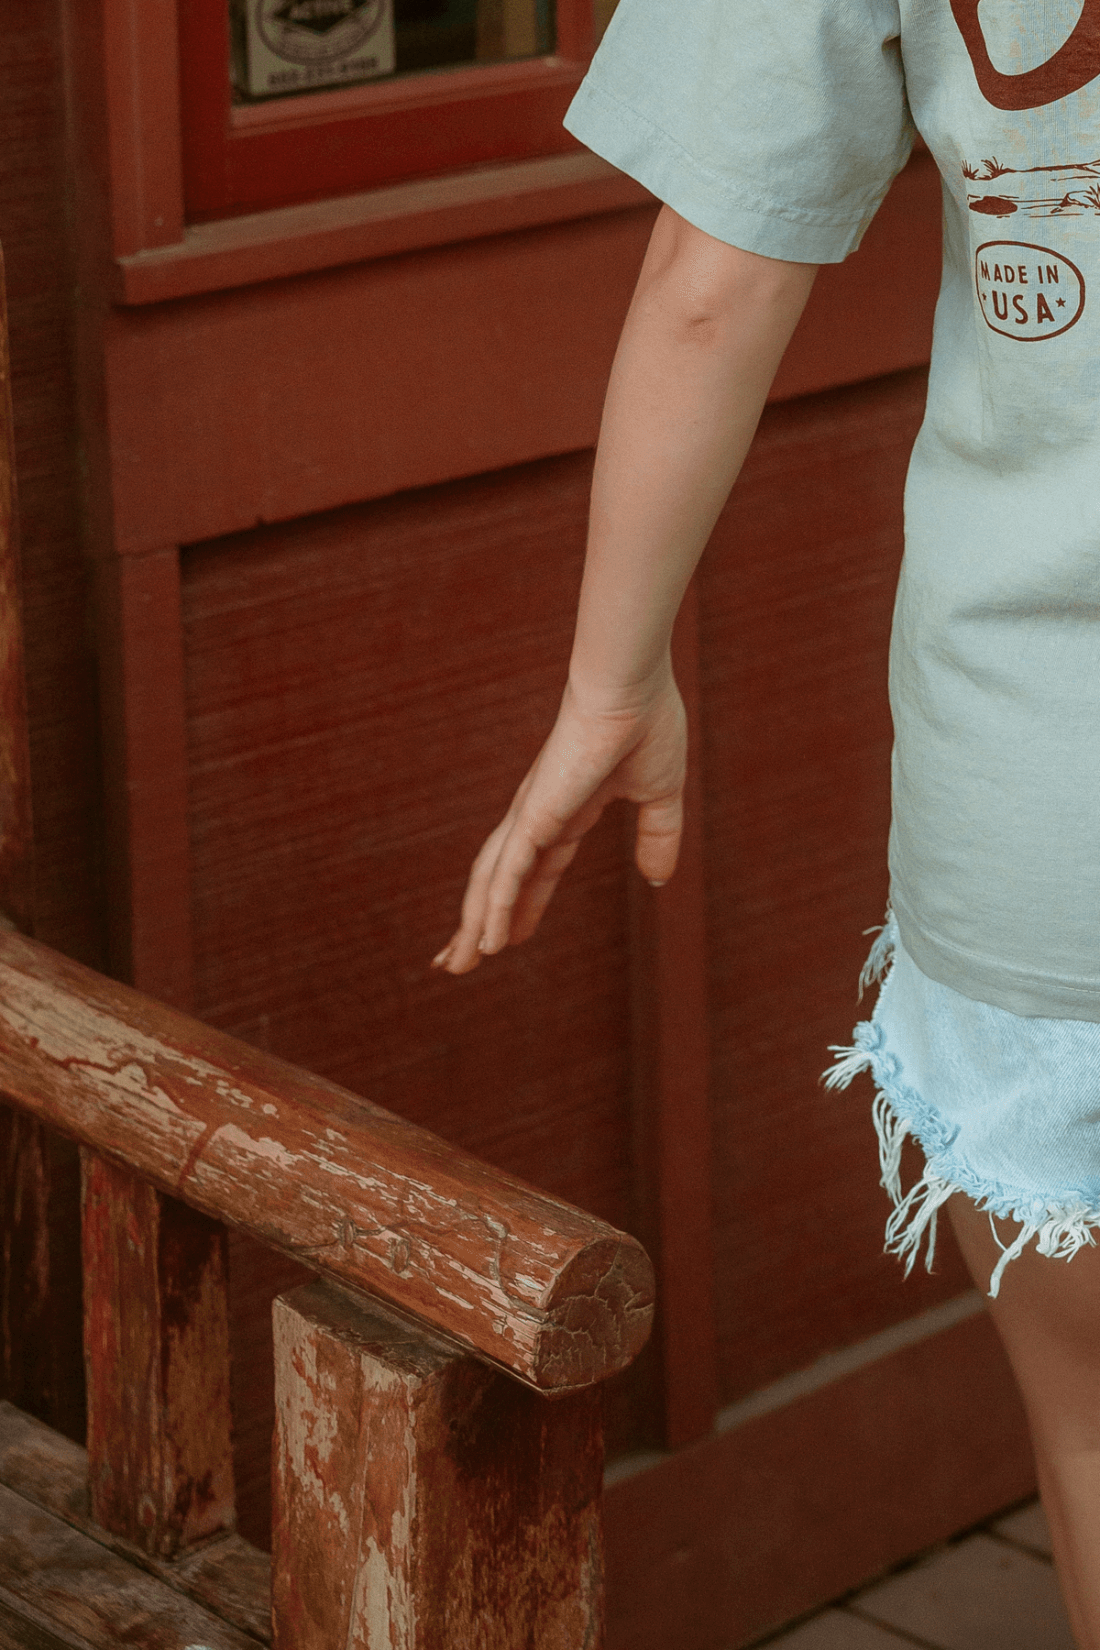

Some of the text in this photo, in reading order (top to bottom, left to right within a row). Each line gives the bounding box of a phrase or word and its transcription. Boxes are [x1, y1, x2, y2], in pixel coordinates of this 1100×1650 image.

[979, 260, 1061, 286] MADE IN
[991, 289, 1057, 326] USA
